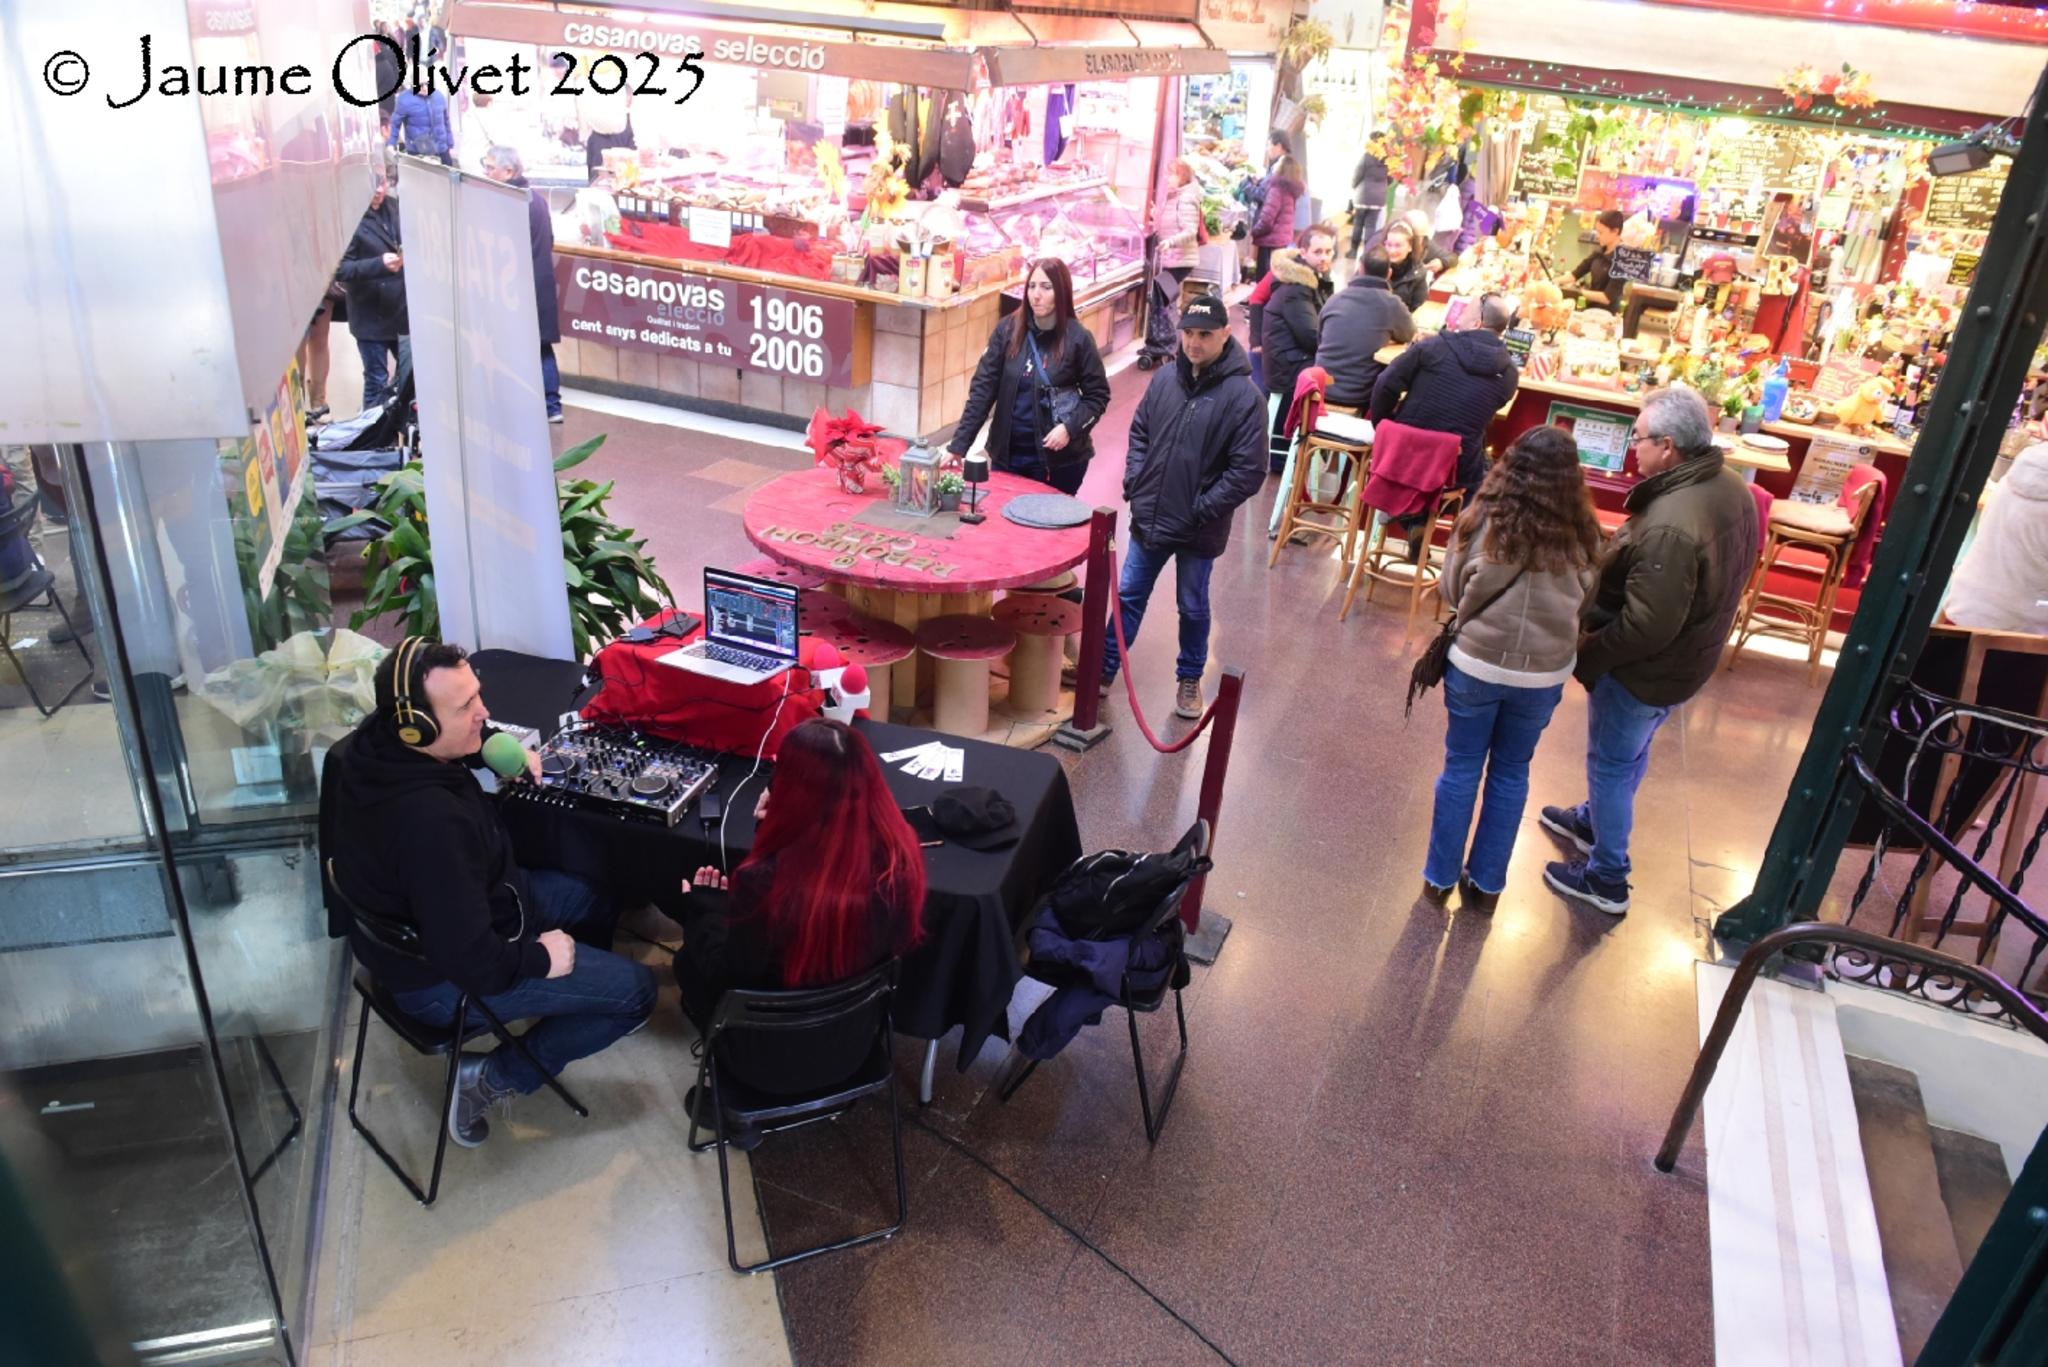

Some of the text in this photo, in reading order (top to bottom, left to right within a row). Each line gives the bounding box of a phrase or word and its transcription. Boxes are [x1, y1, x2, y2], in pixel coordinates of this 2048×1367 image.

[564, 22, 701, 55] casanovas
[575, 267, 725, 312] casanovas
[1760, 255, 1799, 296] R
[571, 318, 732, 357] cent anys dedicats a tu
[750, 295, 824, 339] 1906
[750, 333, 824, 377] 2006
